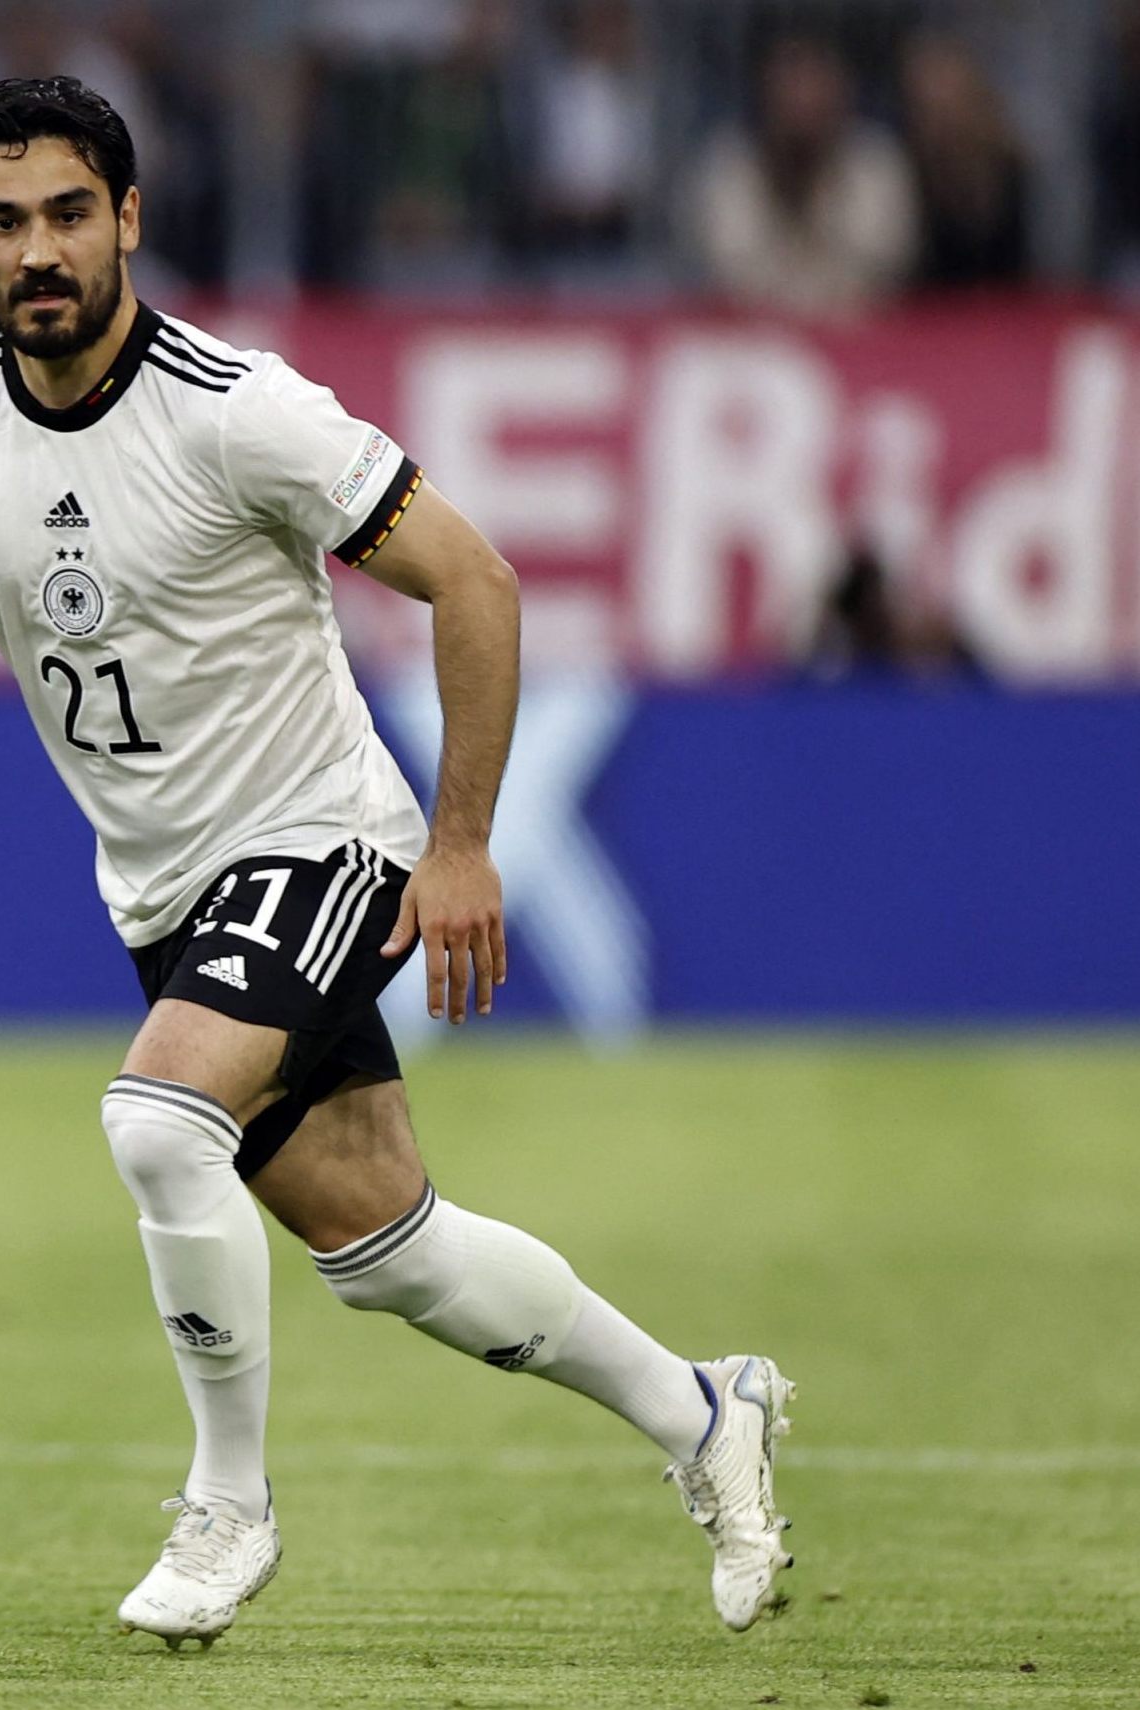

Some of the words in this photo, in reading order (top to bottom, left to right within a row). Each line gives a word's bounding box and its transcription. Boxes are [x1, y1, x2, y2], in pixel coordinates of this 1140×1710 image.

[335, 432, 383, 506] FOUNDATION
[44, 515, 90, 528] adidas
[41, 655, 163, 754] 21
[196, 963, 250, 991] adidas
